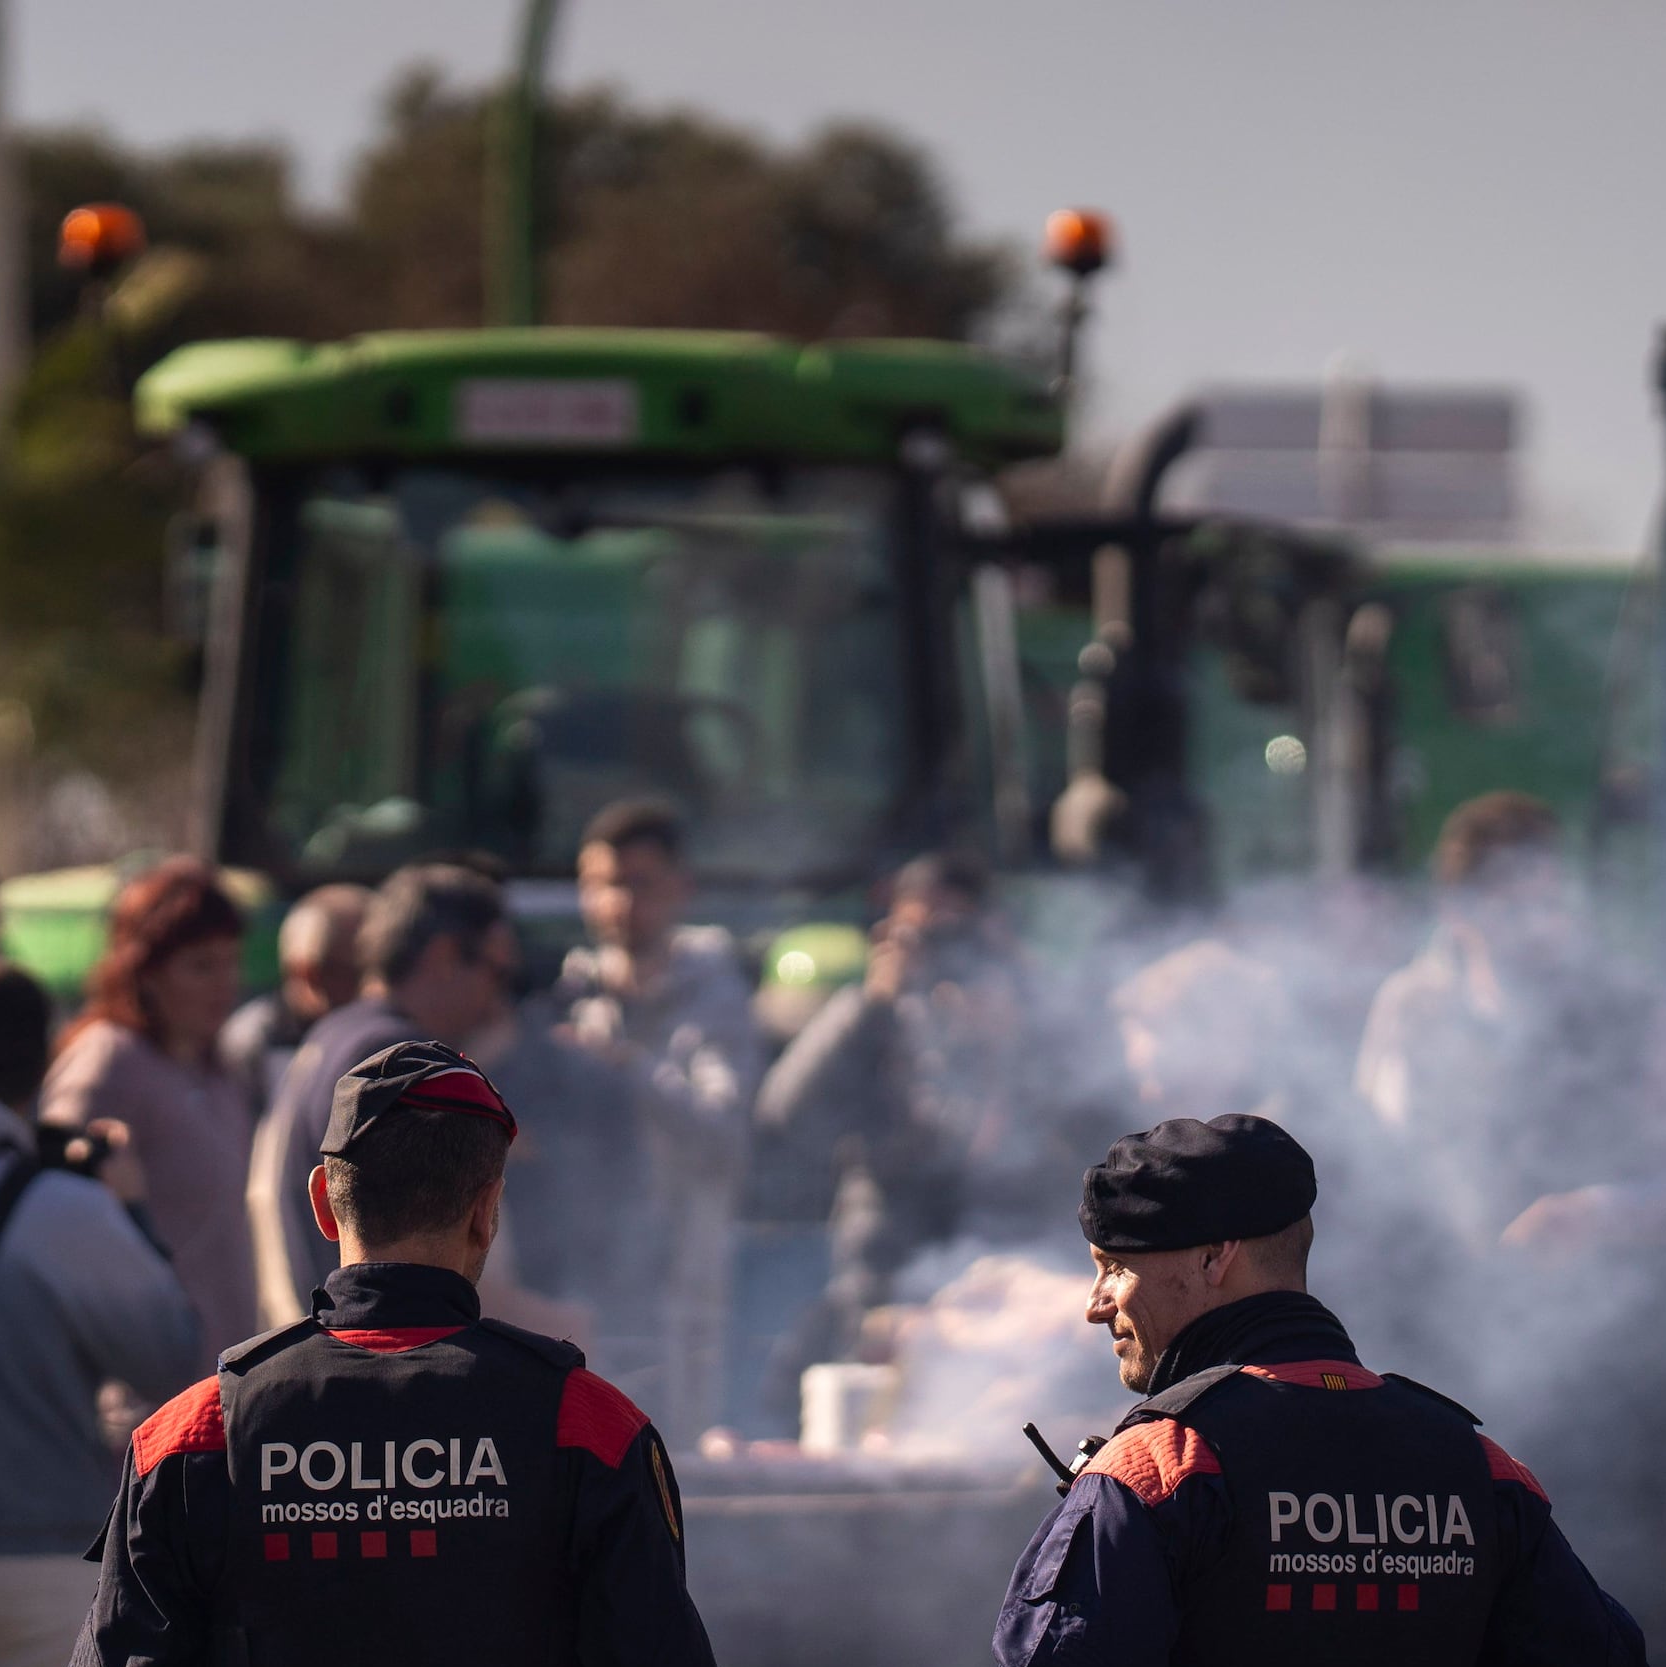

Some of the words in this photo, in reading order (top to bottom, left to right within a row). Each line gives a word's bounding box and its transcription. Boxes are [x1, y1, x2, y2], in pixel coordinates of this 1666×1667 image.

[260, 1436, 509, 1492] POLICIA
[261, 1500, 359, 1524] mossos
[366, 1491, 510, 1524] d'esquadra
[1267, 1491, 1476, 1546] POLICIA
[1268, 1551, 1358, 1574] mossos
